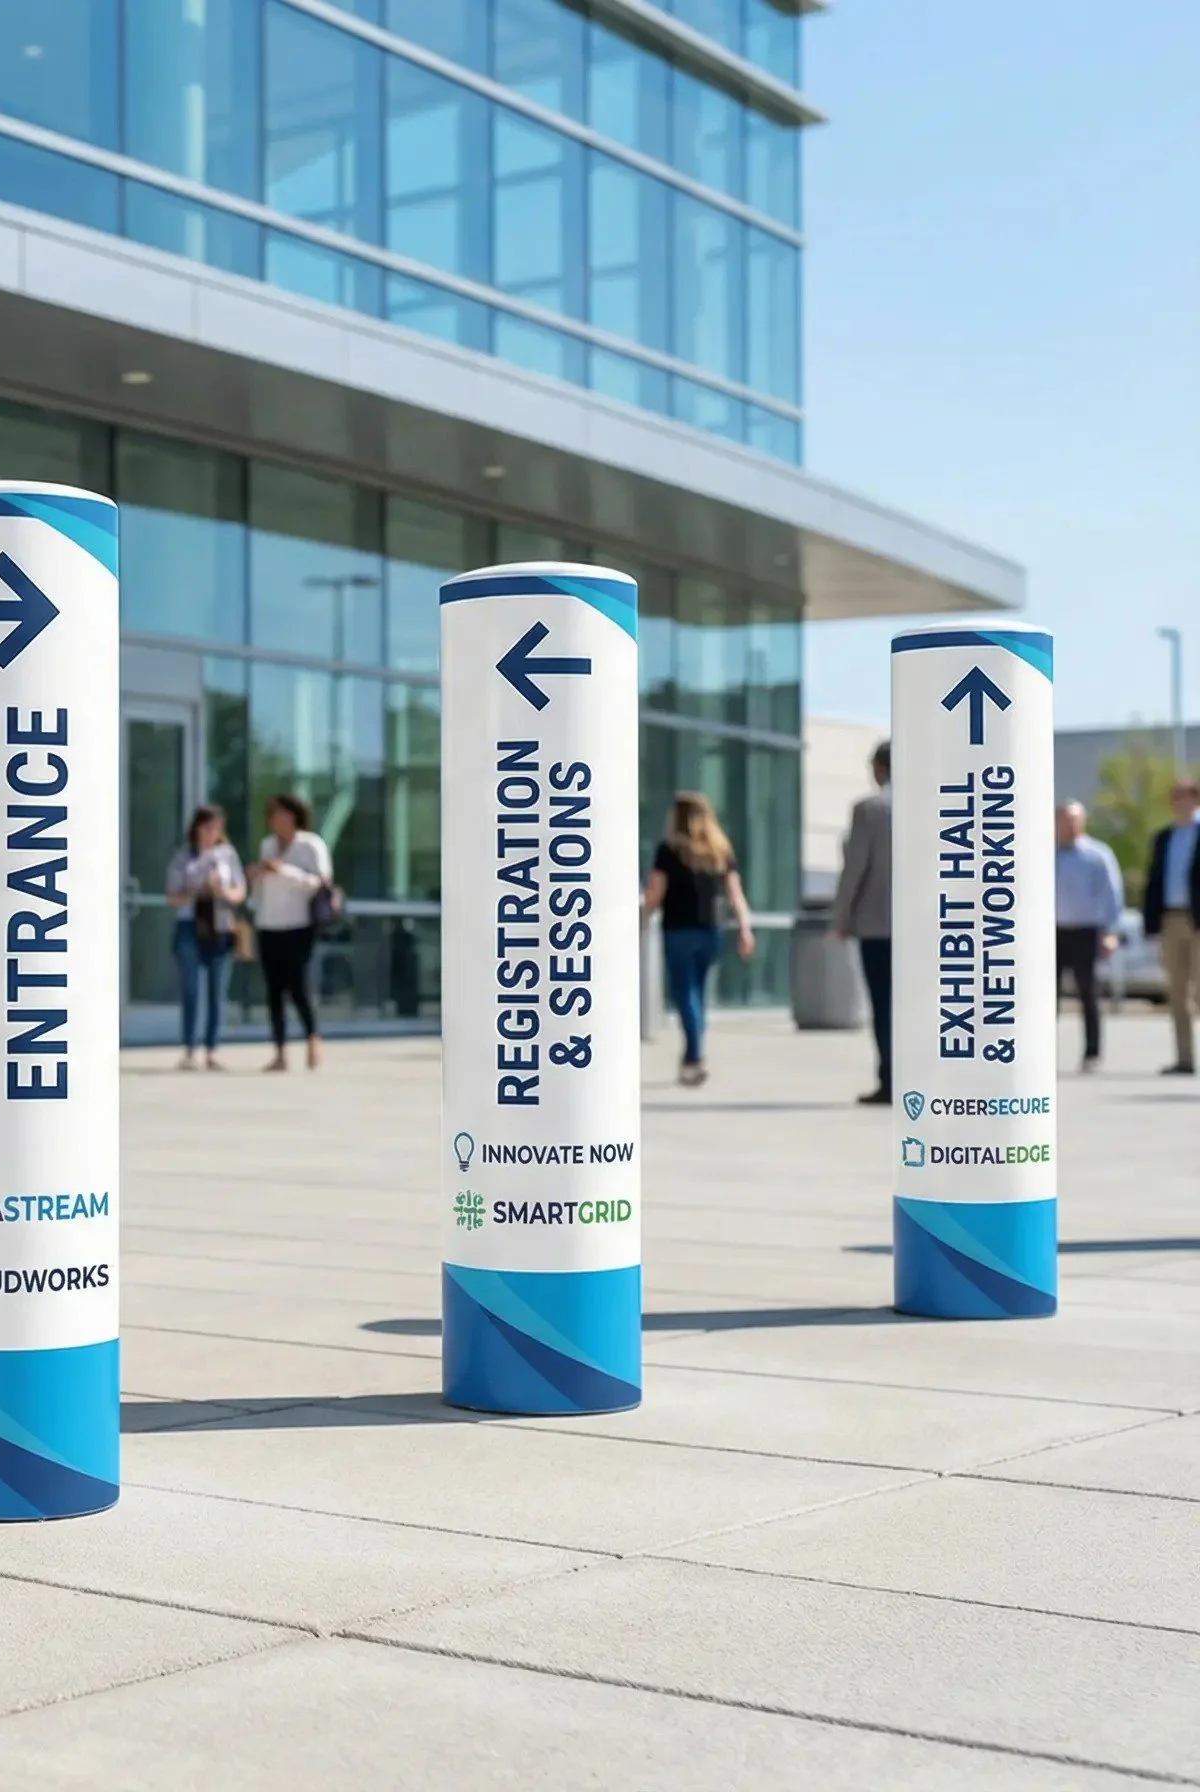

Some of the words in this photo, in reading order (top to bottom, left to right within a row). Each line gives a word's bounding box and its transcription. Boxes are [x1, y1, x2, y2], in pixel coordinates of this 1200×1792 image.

[939, 771, 975, 879] HALL
[5, 706, 69, 1100] ENTRANCE
[496, 740, 541, 1106] REGISTRATION
[548, 761, 592, 1017] SESSIONS
[981, 765, 1016, 1025] NETWORKING
[939, 893, 975, 1059] EXHIBIT
[548, 1034, 593, 1069] &
[982, 1038, 1016, 1064] &
[930, 1096, 1050, 1116] CYBERSECURE
[482, 1143, 584, 1165] INNOVATE
[589, 1142, 634, 1164] NOW
[930, 1144, 1050, 1165] DIGITALEDGE
[492, 1199, 632, 1225] SMARTGRID
